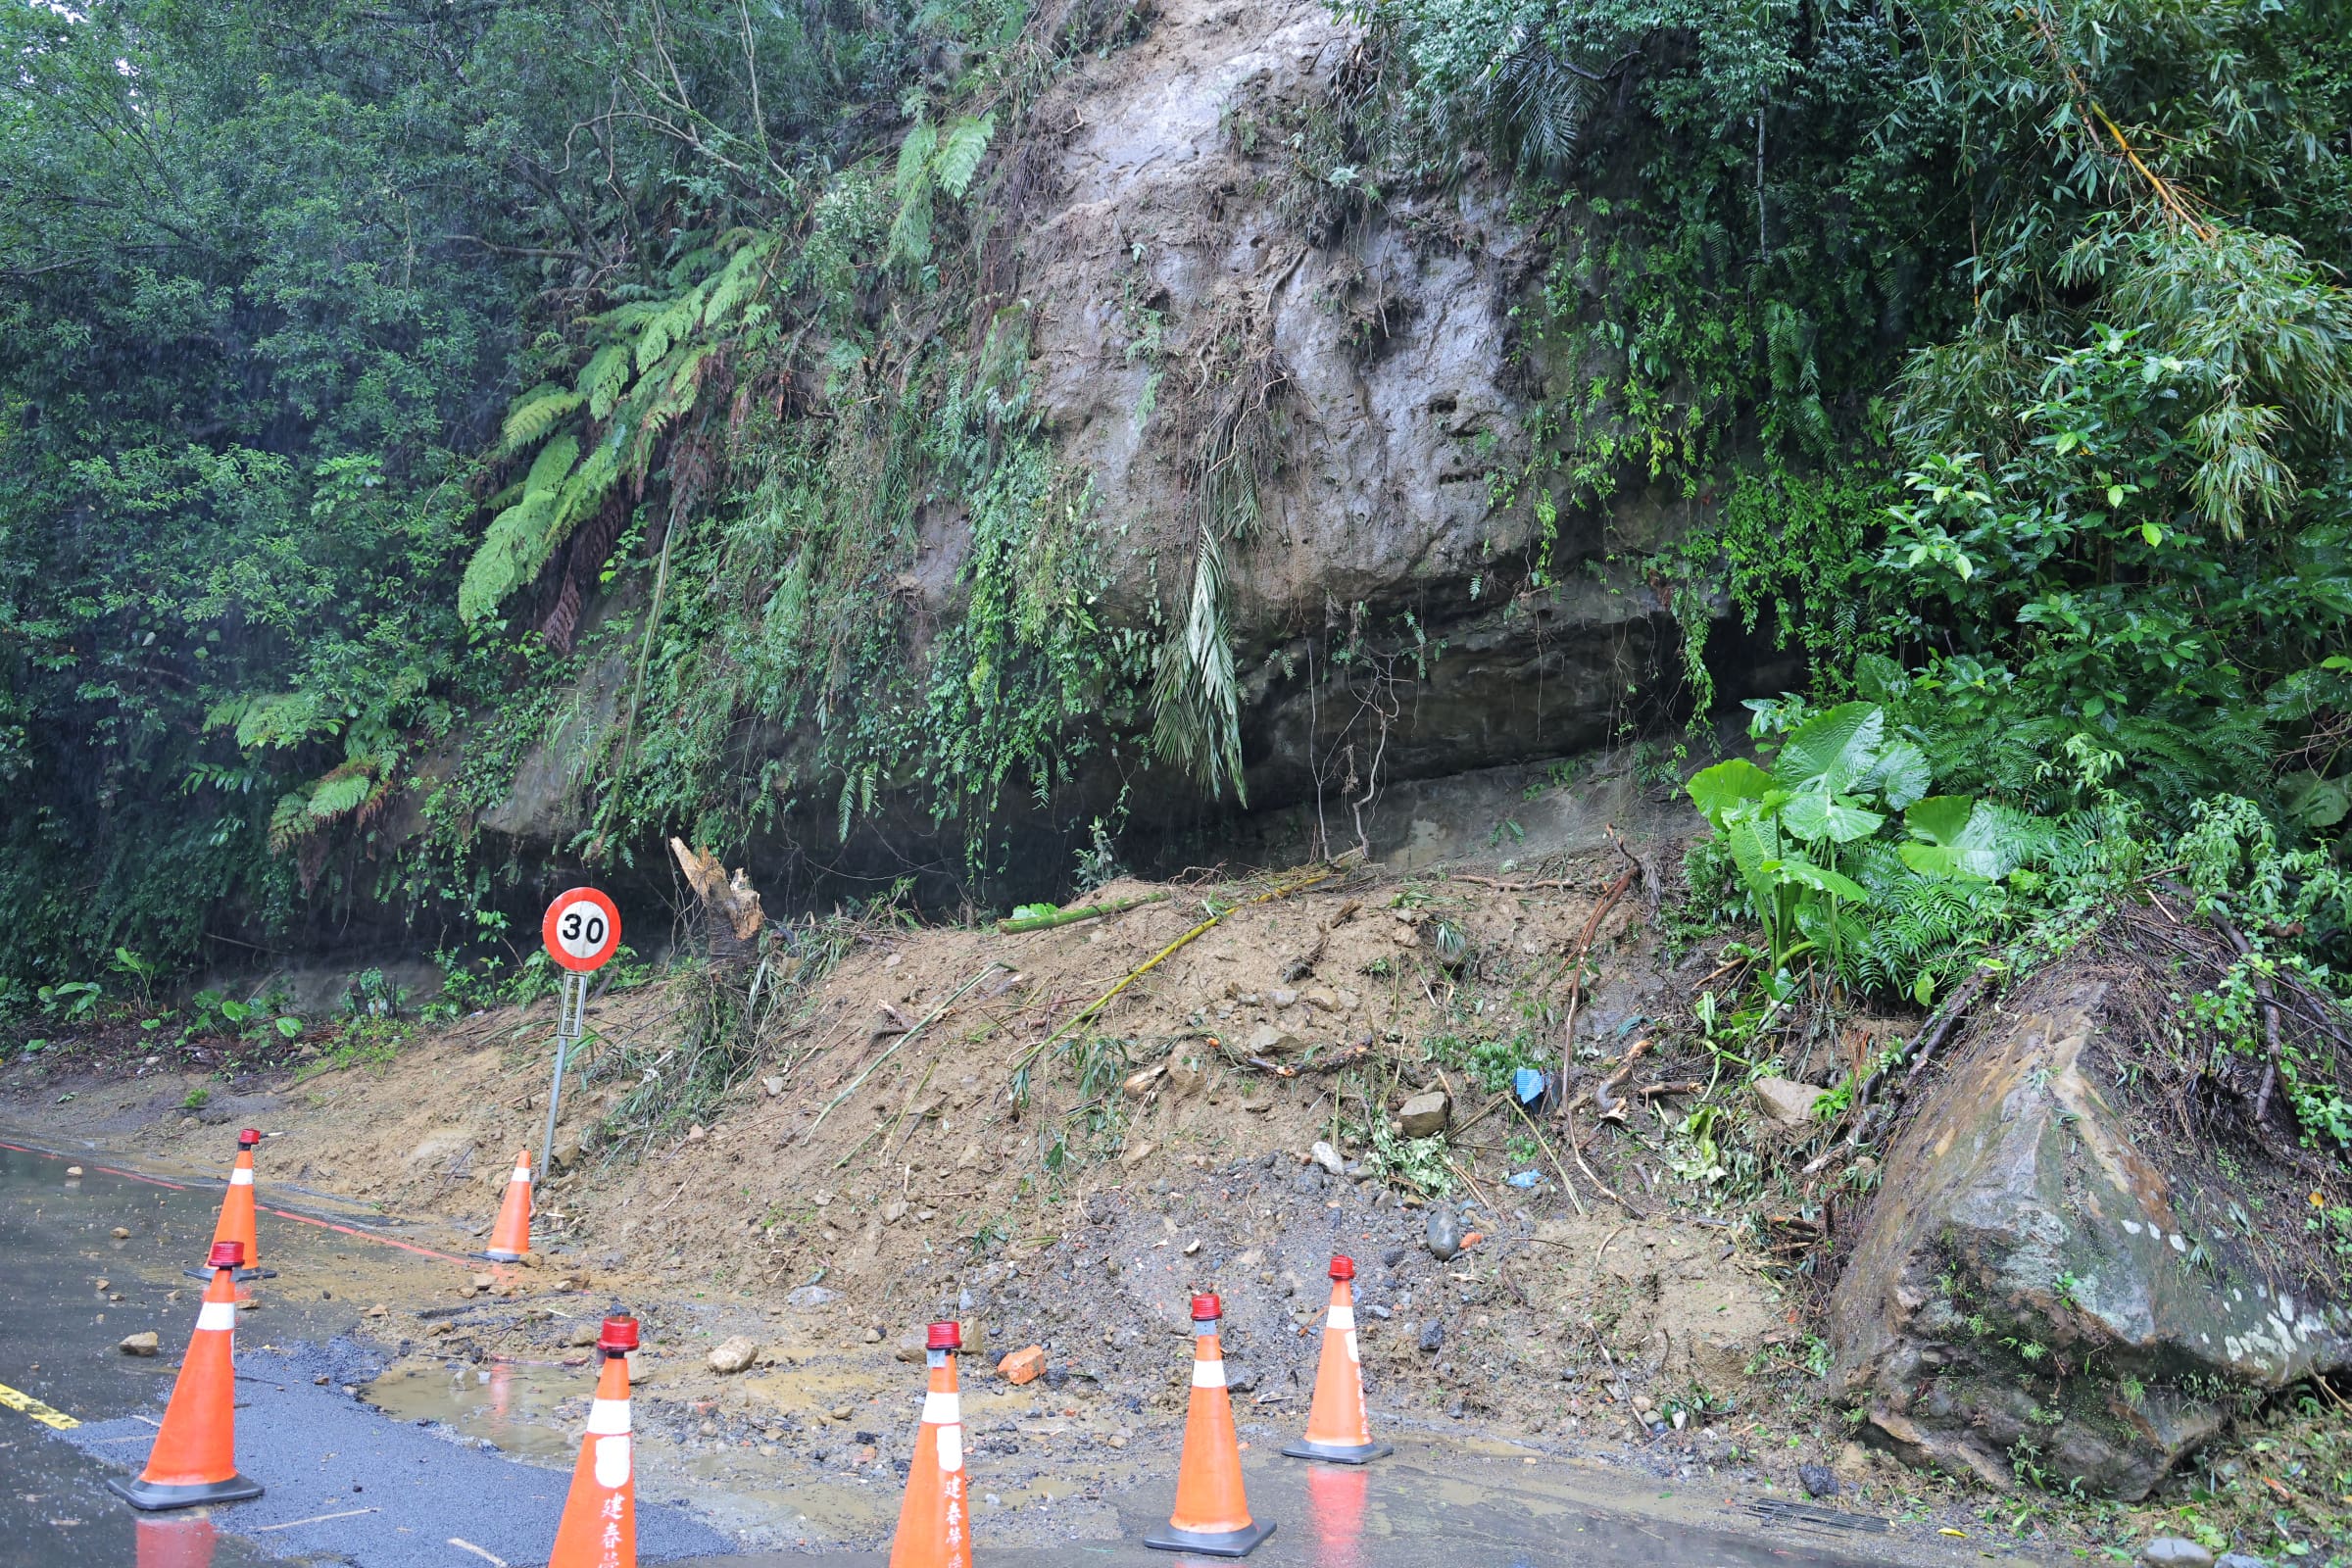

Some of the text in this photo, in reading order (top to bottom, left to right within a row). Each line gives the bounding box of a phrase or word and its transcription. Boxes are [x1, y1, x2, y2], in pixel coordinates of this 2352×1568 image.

[563, 913, 604, 944] 30
[564, 977, 580, 1034] 最高速限
